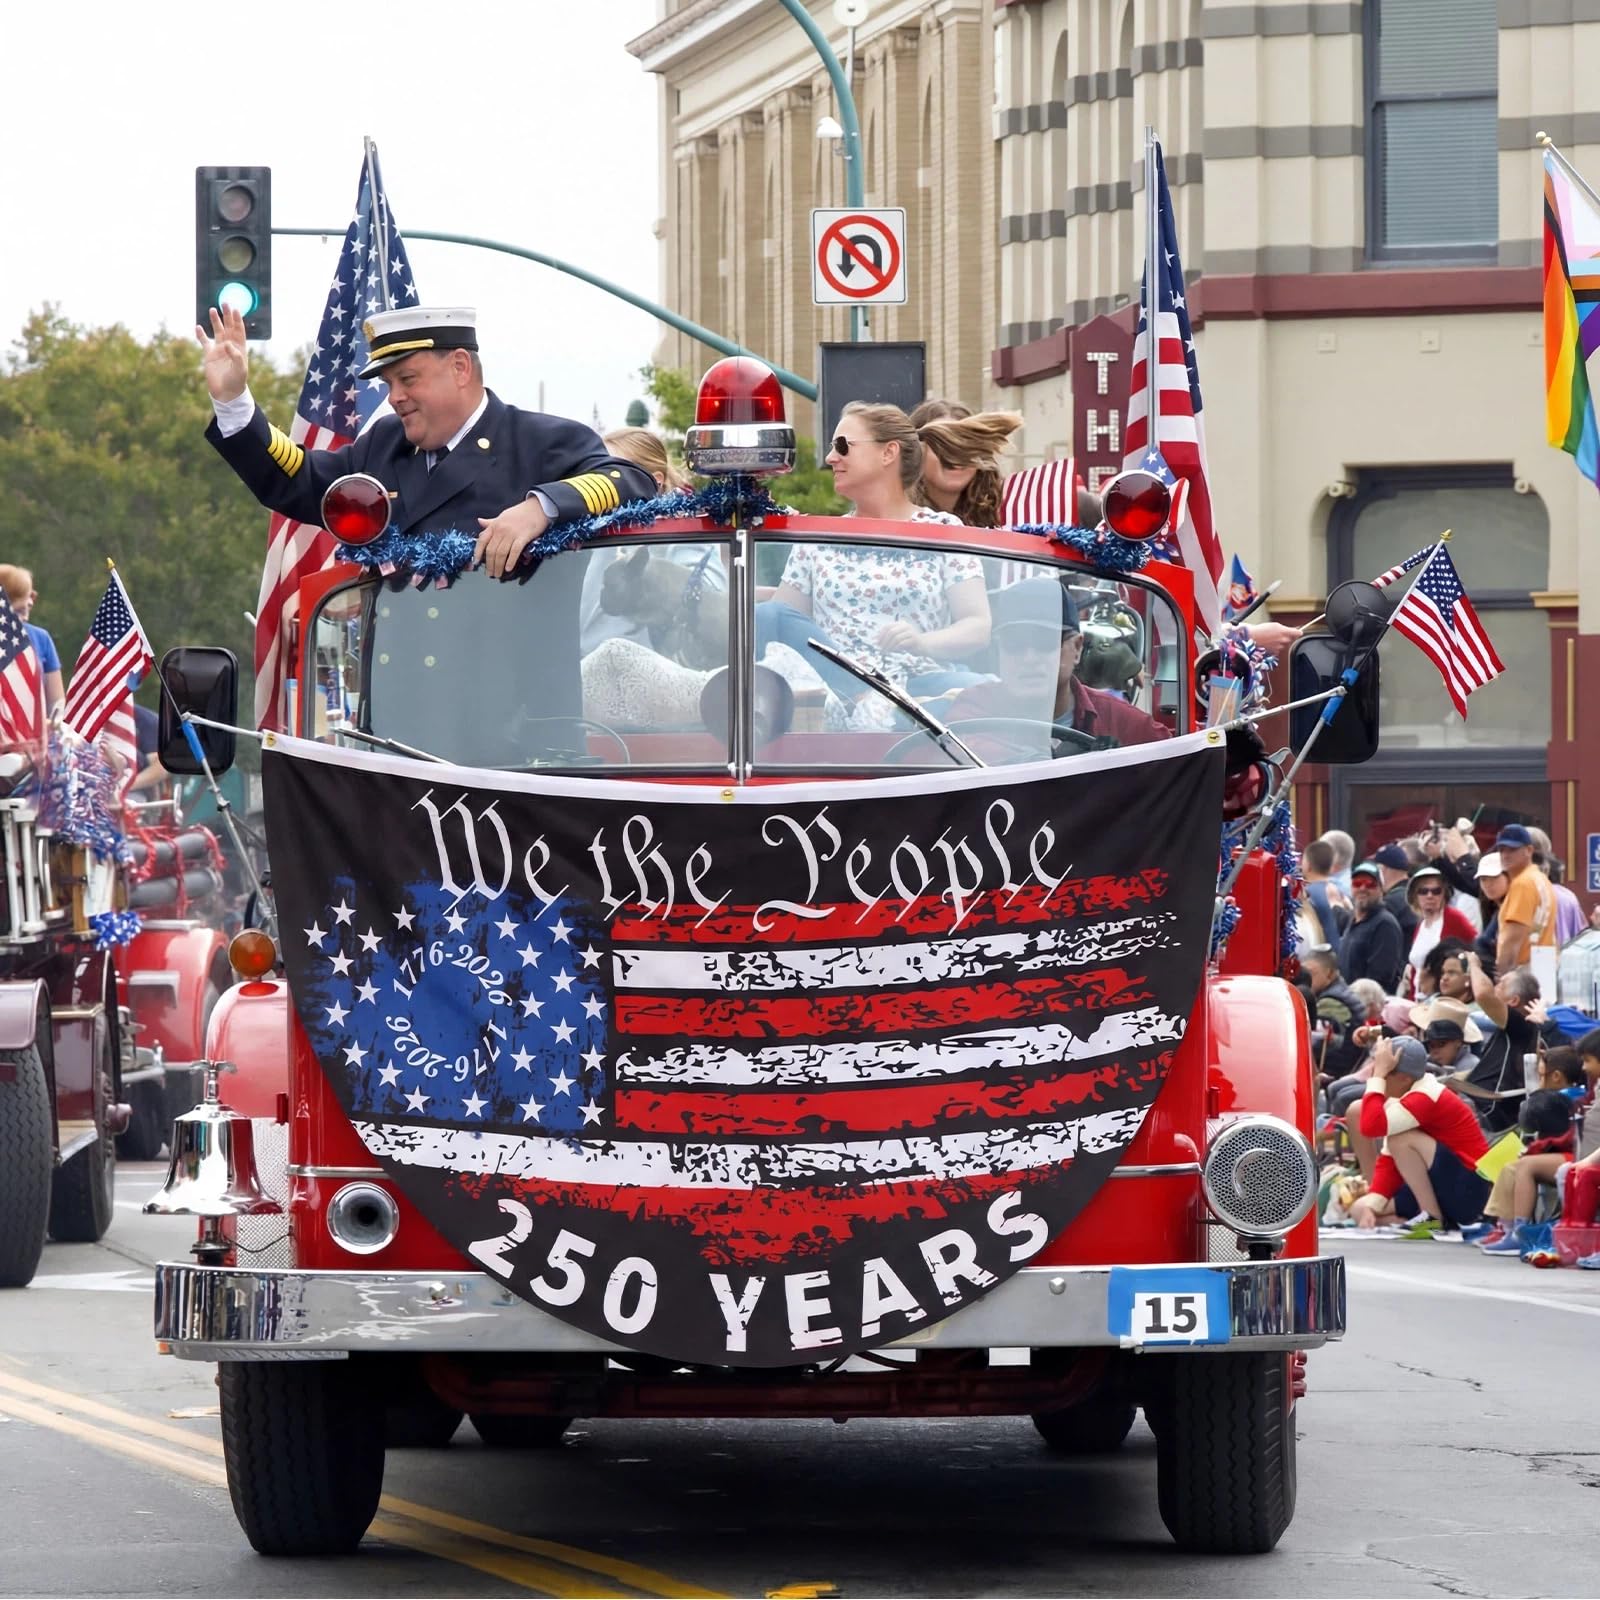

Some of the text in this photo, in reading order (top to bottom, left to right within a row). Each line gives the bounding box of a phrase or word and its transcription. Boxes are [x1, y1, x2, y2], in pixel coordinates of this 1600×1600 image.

[411, 788, 1072, 935] We the People
[393, 940, 513, 1007] 1776-2026
[385, 1019, 507, 1082] 1776-2026
[468, 1190, 1049, 1352] 250 YEARS
[1145, 1296, 1197, 1333] 15
